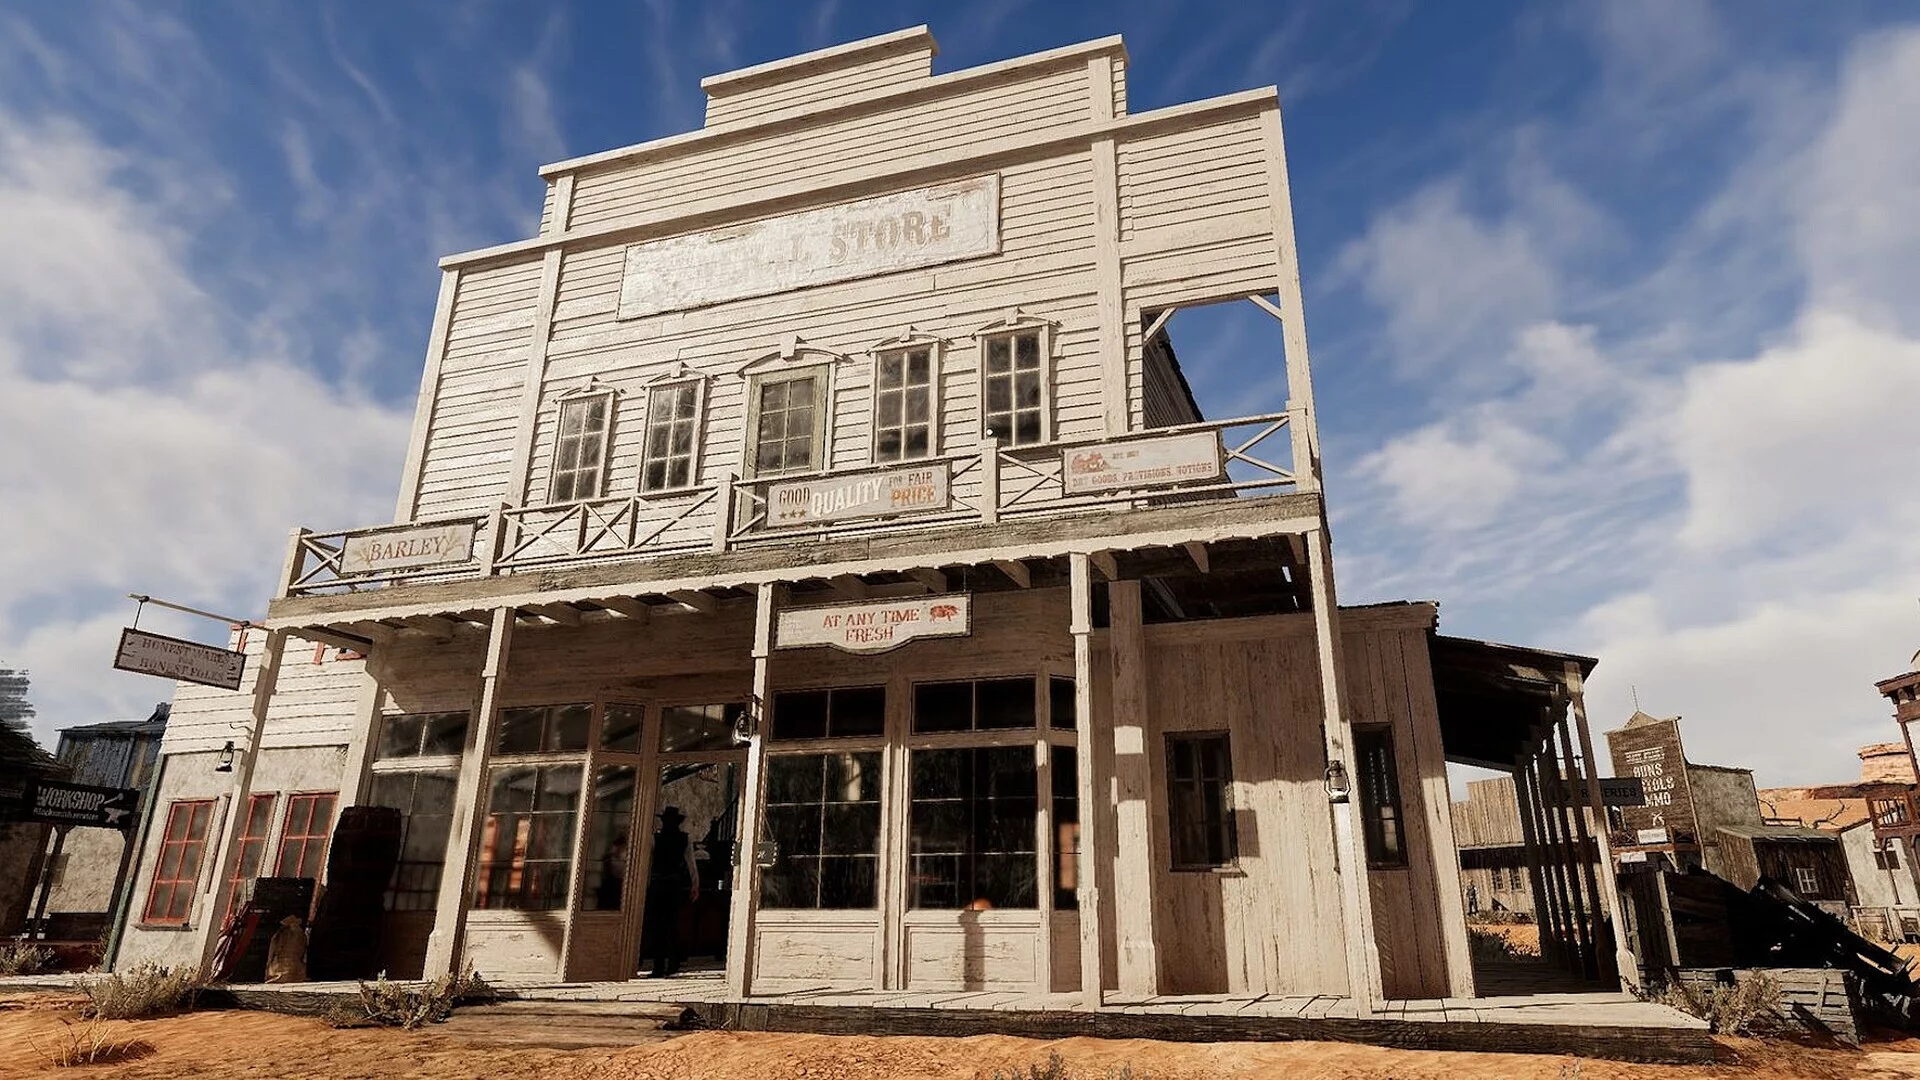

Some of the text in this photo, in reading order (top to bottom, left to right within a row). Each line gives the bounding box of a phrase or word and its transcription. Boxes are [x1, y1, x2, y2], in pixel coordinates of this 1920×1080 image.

[828, 206, 953, 262] STORE
[889, 471, 933, 487] FOR FAIR
[779, 487, 810, 506] GOOD
[811, 477, 884, 518] QUALITY
[891, 486, 936, 507] PRICE
[368, 535, 447, 561] BARLEY
[823, 608, 920, 629] AT ANY TIME
[845, 626, 894, 643] FRESH
[37, 786, 105, 811] WORKSHOP
[1640, 791, 1672, 808] MMO
